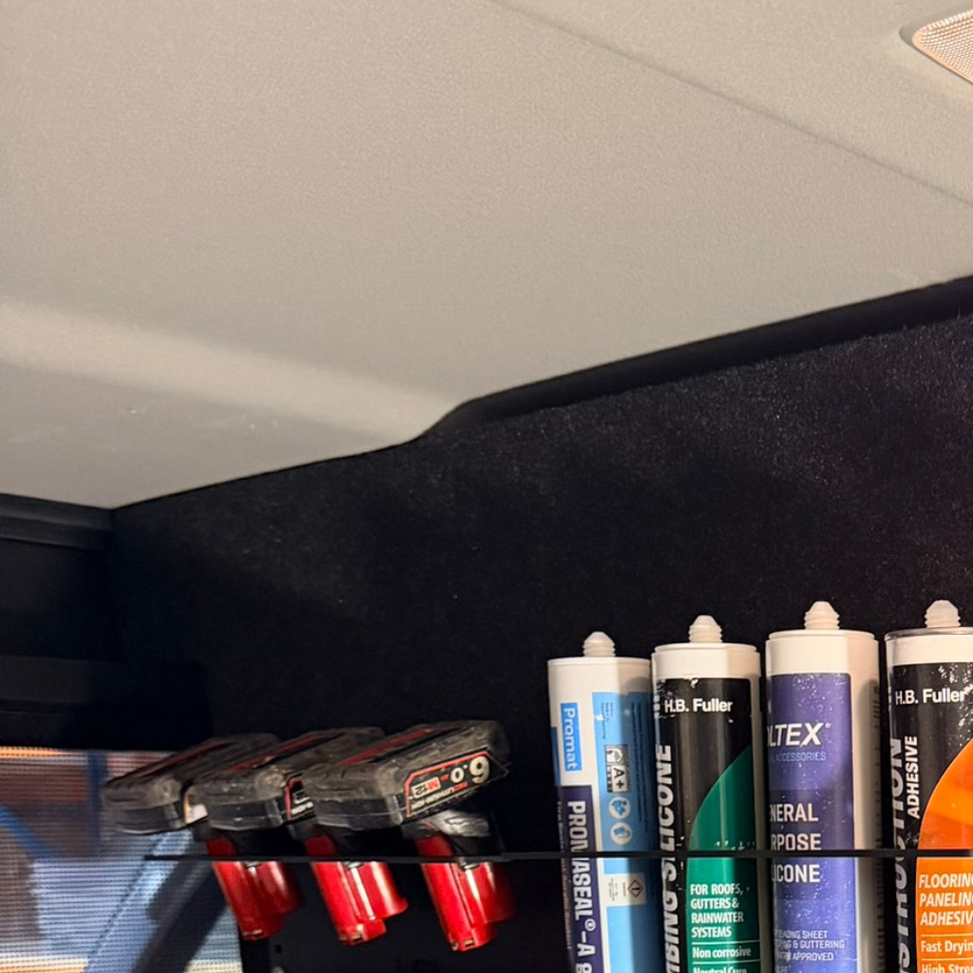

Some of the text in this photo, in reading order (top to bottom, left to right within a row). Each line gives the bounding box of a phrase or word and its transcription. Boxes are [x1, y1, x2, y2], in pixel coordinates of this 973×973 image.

[895, 688, 966, 706] H.B. Fuller
[664, 697, 732, 713] H.B. Fuller
[562, 707, 578, 771] Promat
[767, 722, 825, 747] LTEX
[450, 756, 490, 785] 6.0
[904, 735, 920, 819] ADHESIVE
[769, 802, 819, 823] NERAL
[771, 833, 822, 851] RPOSE
[690, 882, 744, 896] FOR ROOFS,
[690, 897, 731, 910] GUTTERS
[691, 911, 744, 924] RAINWATER
[691, 926, 733, 938] SYSTEMS
[802, 930, 829, 939] SHEET
[800, 940, 846, 949] GUTTERING
[921, 940, 942, 953] Fast
[692, 946, 752, 959] Non corrosive
[792, 952, 834, 961] APPROVED
